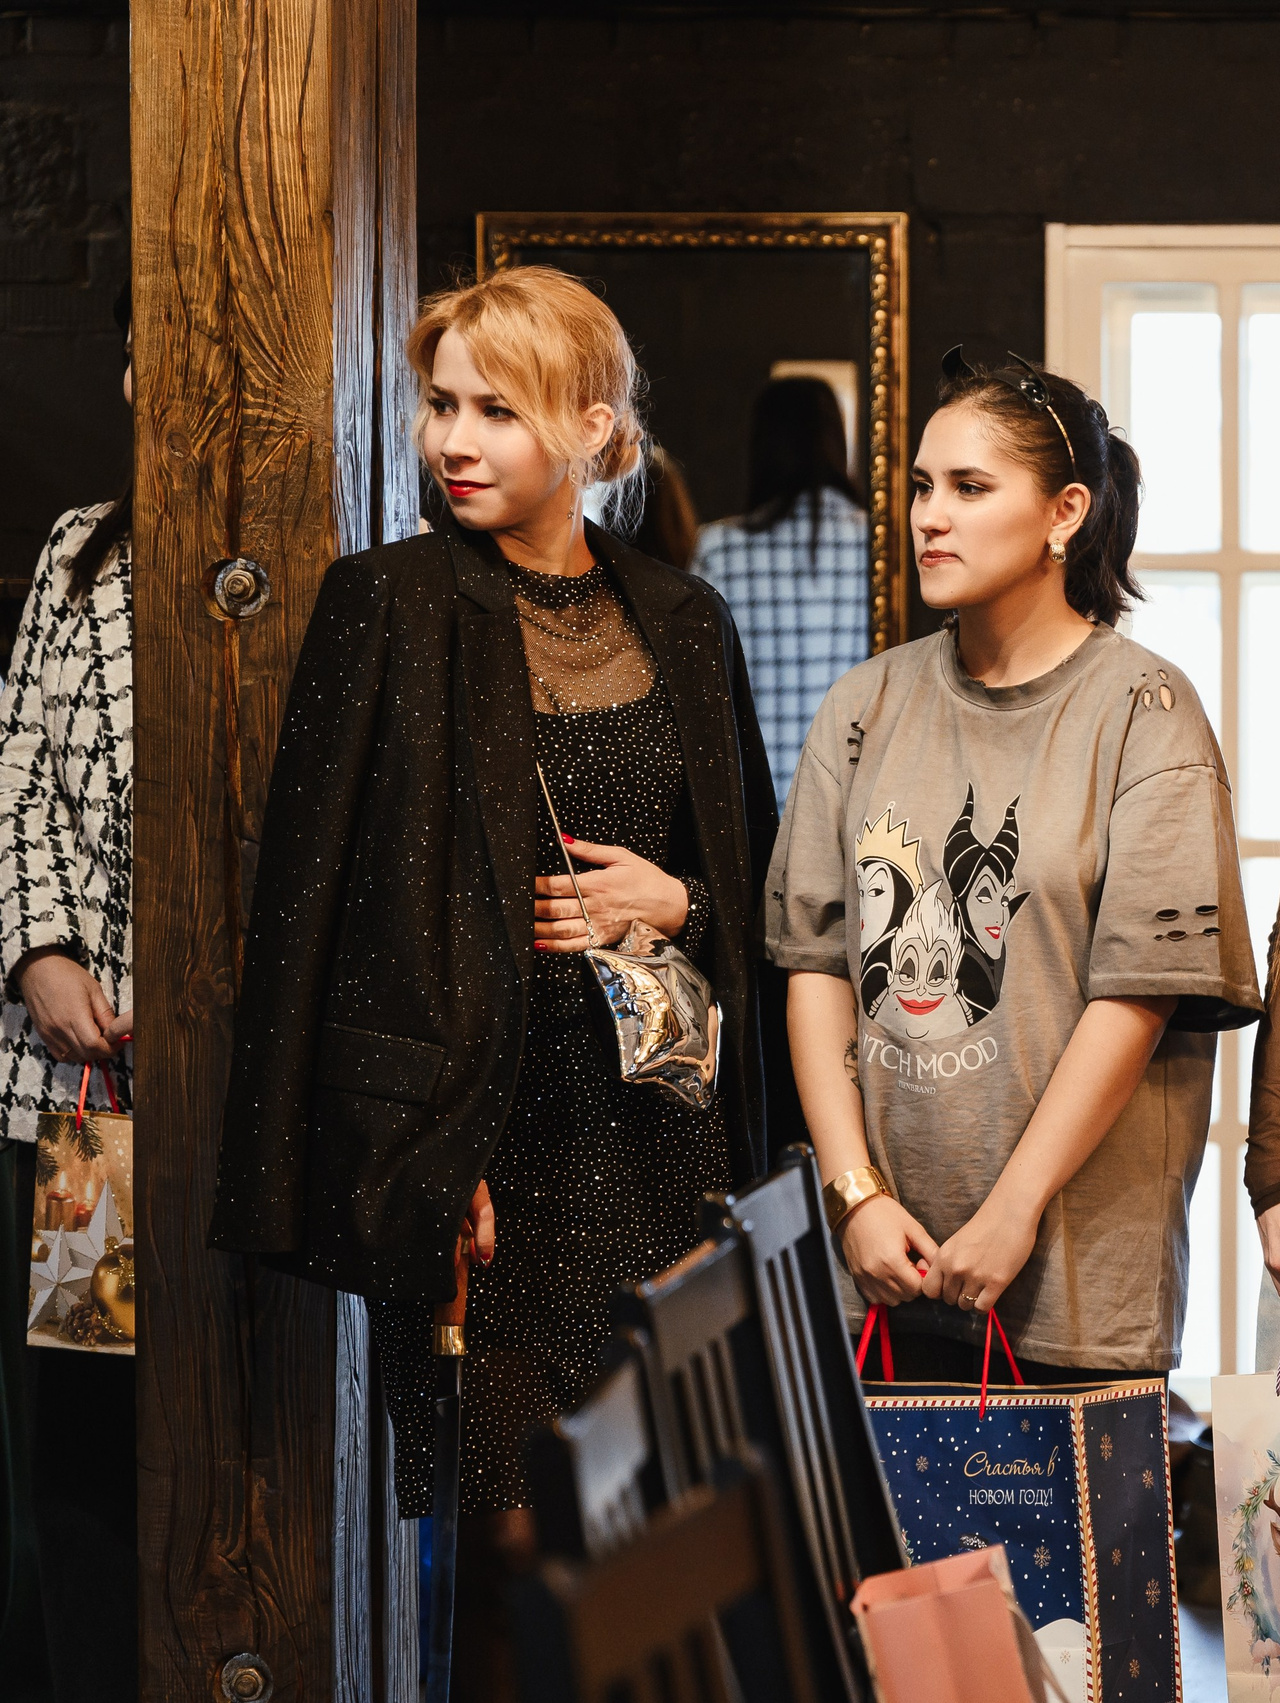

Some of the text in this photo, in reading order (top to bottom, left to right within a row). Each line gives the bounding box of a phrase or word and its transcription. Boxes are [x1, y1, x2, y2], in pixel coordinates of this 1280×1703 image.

[915, 1036, 999, 1080] MOOD
[963, 1450, 1044, 1478] Счастья
[968, 1487, 1054, 1507] НОВОМ ГОДУ!
